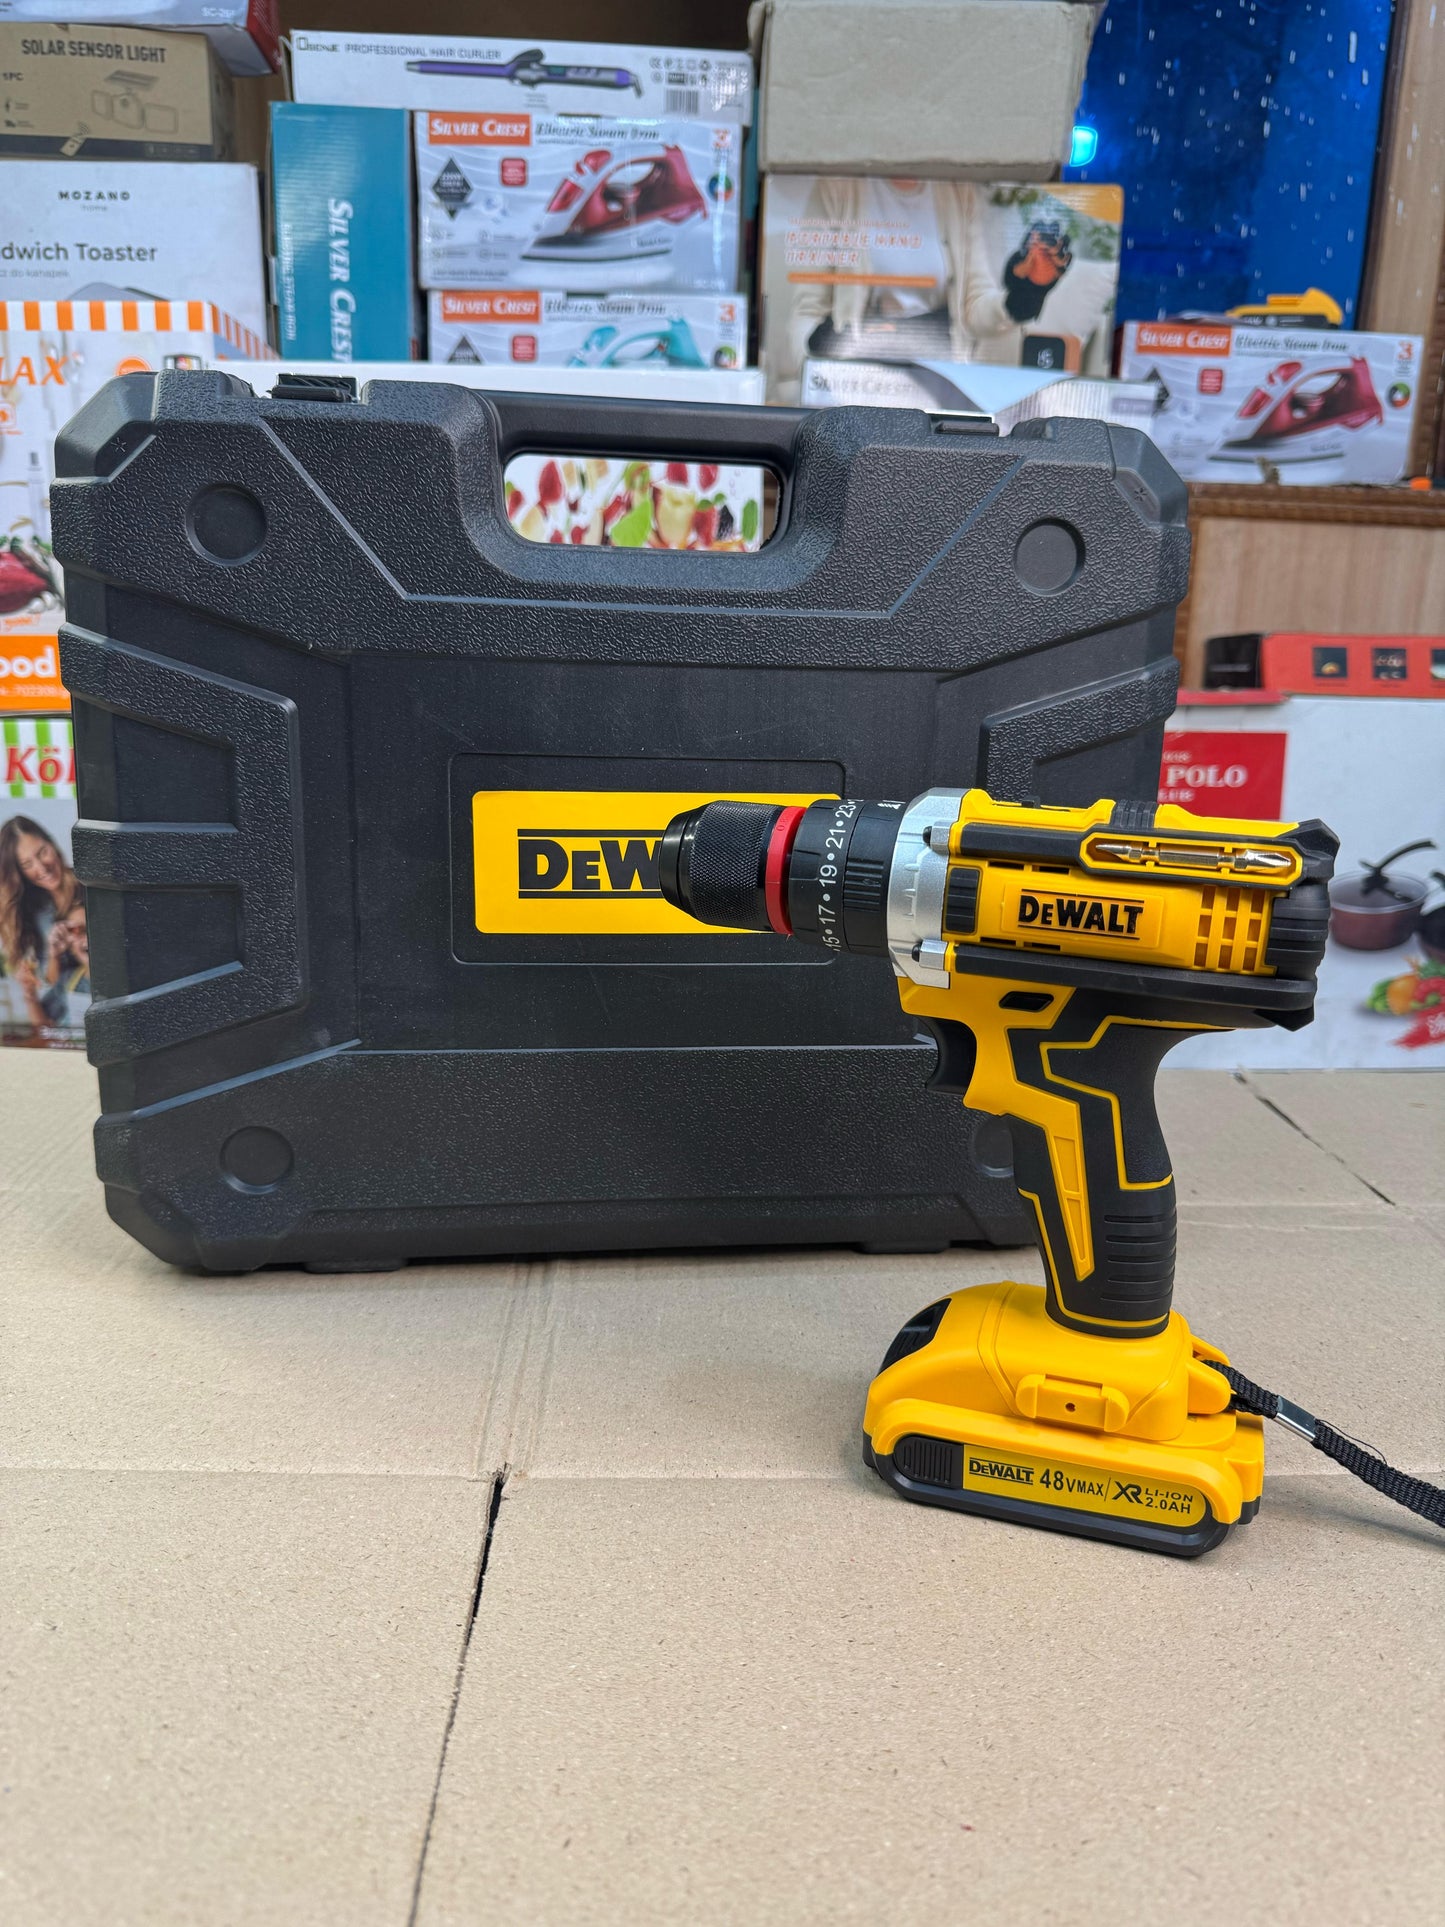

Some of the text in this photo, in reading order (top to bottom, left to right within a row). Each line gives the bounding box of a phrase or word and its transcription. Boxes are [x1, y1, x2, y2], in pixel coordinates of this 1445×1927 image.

[21, 39, 167, 63] SOLAR SENSOR LIGHT
[345, 43, 426, 57] PROFESSIONAL
[458, 48, 501, 59] CURLER
[431, 118, 527, 137] SILVER CREST
[57, 191, 131, 201] MOZANO
[2, 241, 158, 261] dwich Toaster
[328, 198, 357, 363] SILVER CREST
[445, 299, 537, 315] SILVER CREST
[719, 304, 736, 322] 3
[1139, 329, 1230, 349] SILVER CREST
[1165, 764, 1249, 788] POLO
[835, 803, 857, 819] 23
[826, 828, 847, 850] 21
[818, 864, 838, 888] 19
[818, 904, 837, 925] 17
[1112, 1481, 1144, 1505] XR
[1144, 1488, 1193, 1503] LI-ION
[1145, 1496, 1191, 1515] 2.0AH
